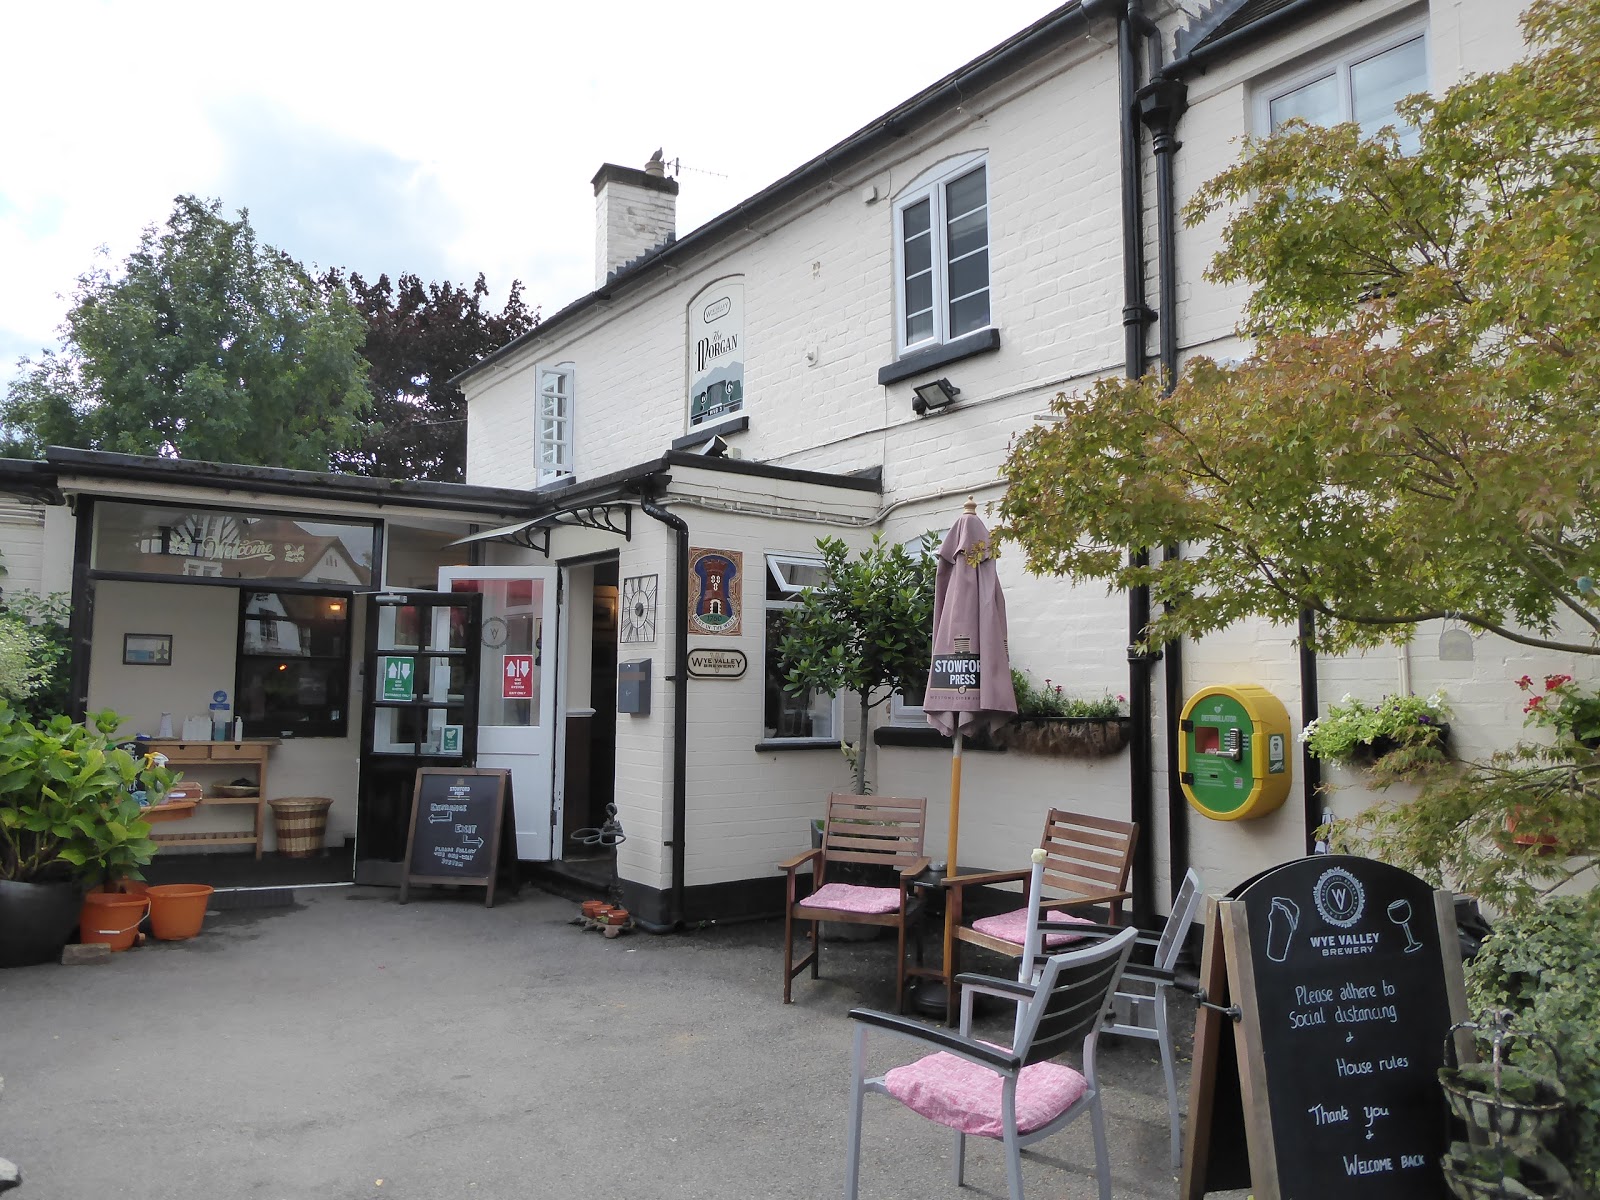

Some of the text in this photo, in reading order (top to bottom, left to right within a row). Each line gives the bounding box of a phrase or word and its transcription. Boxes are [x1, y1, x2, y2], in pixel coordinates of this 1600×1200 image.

[696, 333, 738, 373] MORGAN
[201, 536, 275, 561] Welcome
[691, 657, 743, 668] WYE VALLEY
[949, 673, 976, 685] PRESS
[1201, 714, 1237, 722] DEFIBRILLATOR
[455, 824, 477, 834] EXIT
[455, 846, 477, 854] FOLLOW
[1310, 932, 1380, 948] WYE VALLEY
[1321, 946, 1374, 957] BREWERY
[1294, 979, 1396, 1006] Please adhere to
[1288, 1004, 1398, 1029] Social distancing
[1336, 1055, 1409, 1077] House rules
[1307, 1103, 1390, 1127] Thank you
[1342, 1154, 1426, 1176] WELCOME BACK
